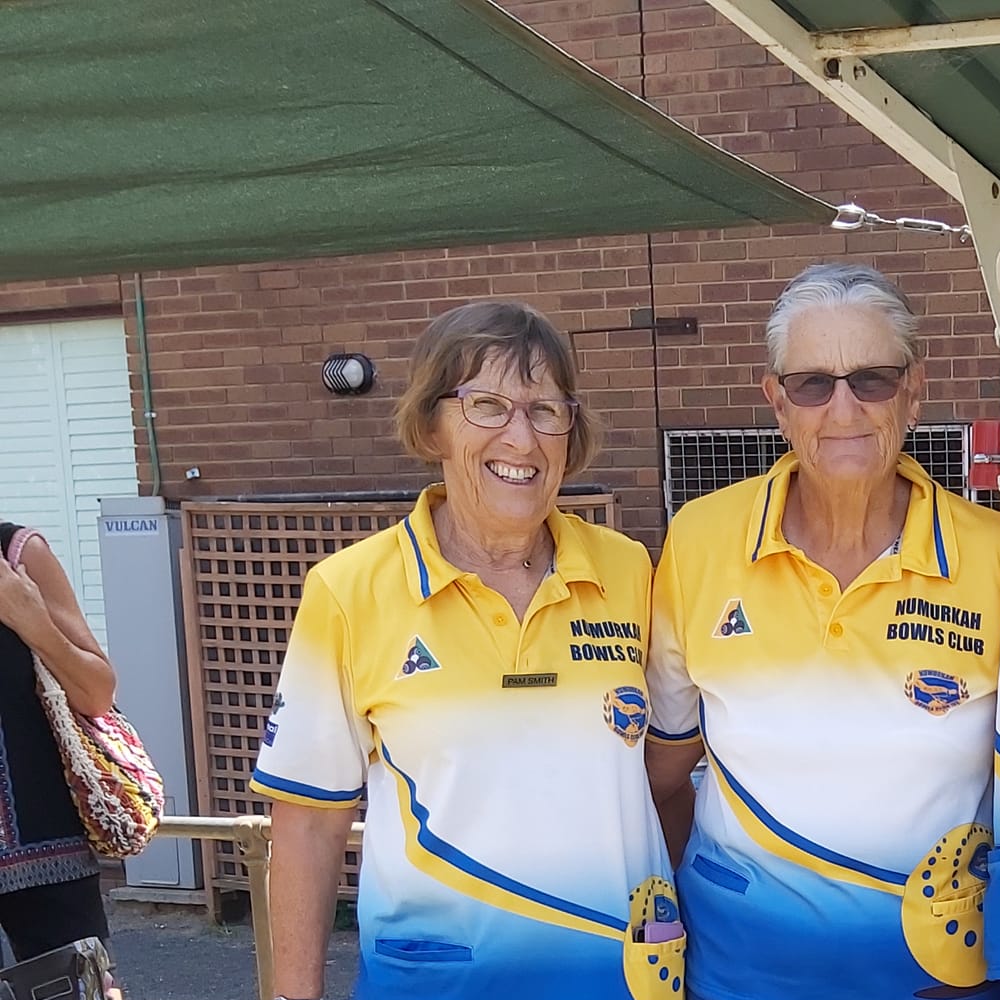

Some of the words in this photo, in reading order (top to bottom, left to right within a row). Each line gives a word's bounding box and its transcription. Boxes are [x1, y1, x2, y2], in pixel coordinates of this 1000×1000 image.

[105, 519, 157, 531] VULCAN
[895, 597, 982, 630] NUMURKAH
[887, 622, 944, 645] BOWLS
[948, 631, 985, 656] CLUB
[569, 643, 626, 662] BOWLS
[507, 677, 526, 685] PAM
[527, 675, 555, 685] SMITH
